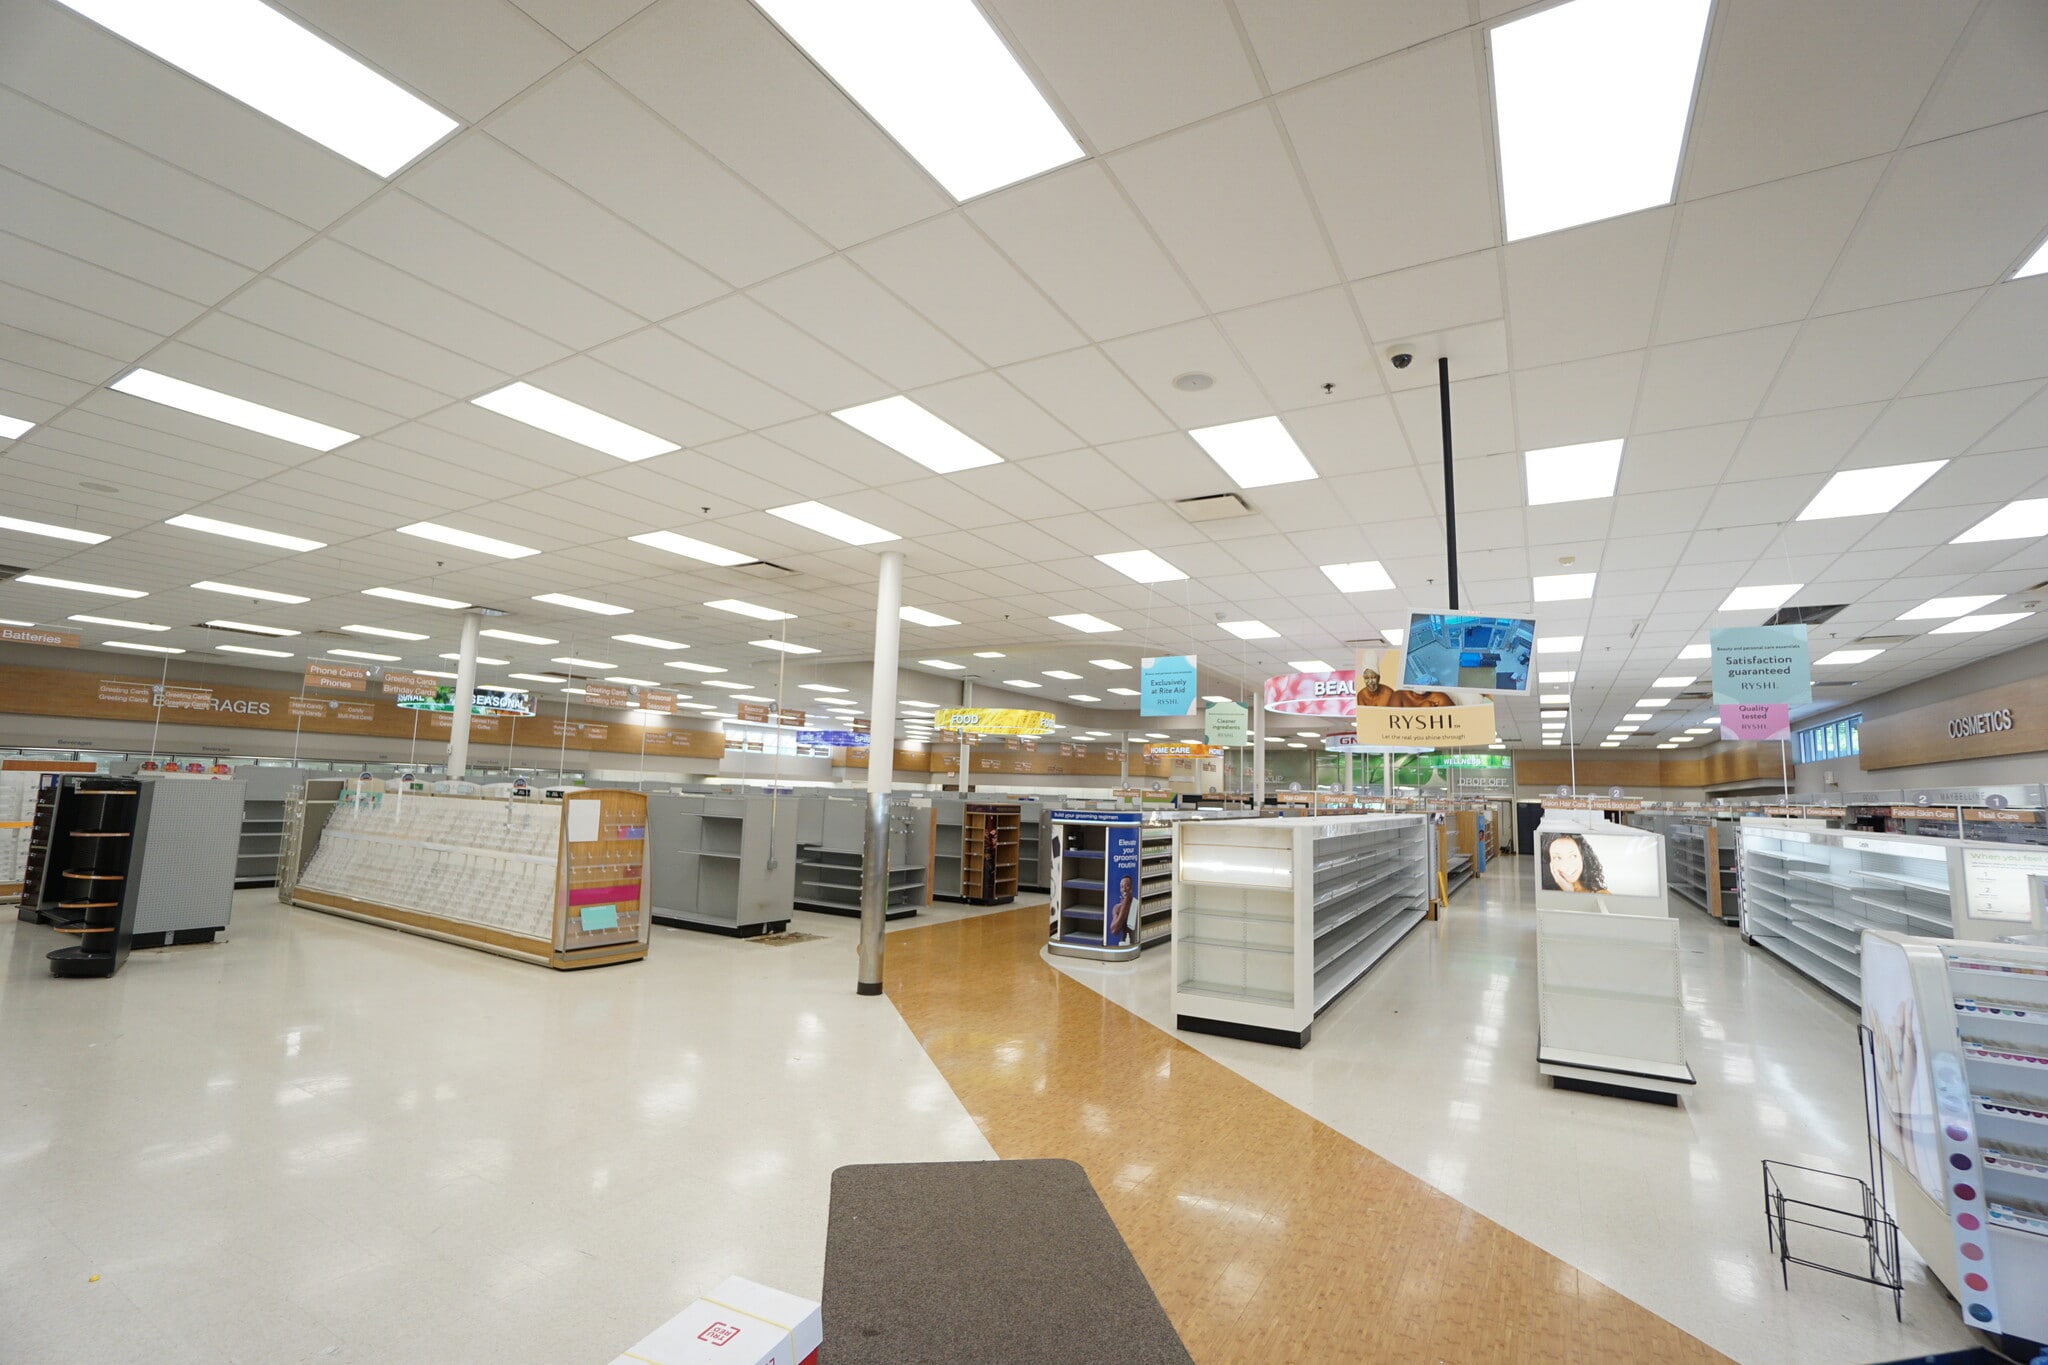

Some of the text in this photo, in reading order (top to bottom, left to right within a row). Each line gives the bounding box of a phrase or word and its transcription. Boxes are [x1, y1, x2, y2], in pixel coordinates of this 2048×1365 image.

[2, 629, 62, 644] Batteries
[1726, 655, 1792, 665] Satisfaction
[310, 665, 363, 678] Phone Cards
[1728, 666, 1791, 678] guaranteed
[320, 678, 351, 689] Phones
[385, 673, 436, 686] Greeting Cards
[1150, 678, 1186, 686] Exclusively
[100, 685, 128, 694] Greeting
[1741, 681, 1776, 690] RYSHI
[383, 684, 436, 697] Birthday Cards
[586, 685, 627, 696] Greeting Cards
[98, 693, 128, 703] Greeting
[165, 691, 211, 701] Greeting Cards
[585, 695, 627, 706] Greeting Cards
[647, 693, 672, 701] Seasonal
[164, 698, 191, 707] Greeting
[646, 702, 671, 711] Seasonal
[1738, 704, 1769, 713] Quality
[951, 714, 979, 725] FOOD
[1389, 714, 1452, 730] RYSHI
[1948, 708, 2012, 738] COSMETICS
[1459, 777, 1507, 787] DROP OFF
[1561, 788, 1567, 796] 3
[1613, 789, 1620, 798] 2
[1940, 791, 1985, 801] MAYBELLINE
[1559, 799, 1572, 807] Hair
[1919, 795, 1927, 804] 2
[1993, 798, 1999, 806] 1
[1611, 802, 1624, 810] Body
[1893, 808, 1915, 817] Facial
[1916, 809, 1934, 817] Skin
[1978, 811, 2019, 820] Nail Care
[1970, 852, 2000, 860] When
[706, 1331, 725, 1341] TRU
[713, 1327, 732, 1336] RED
